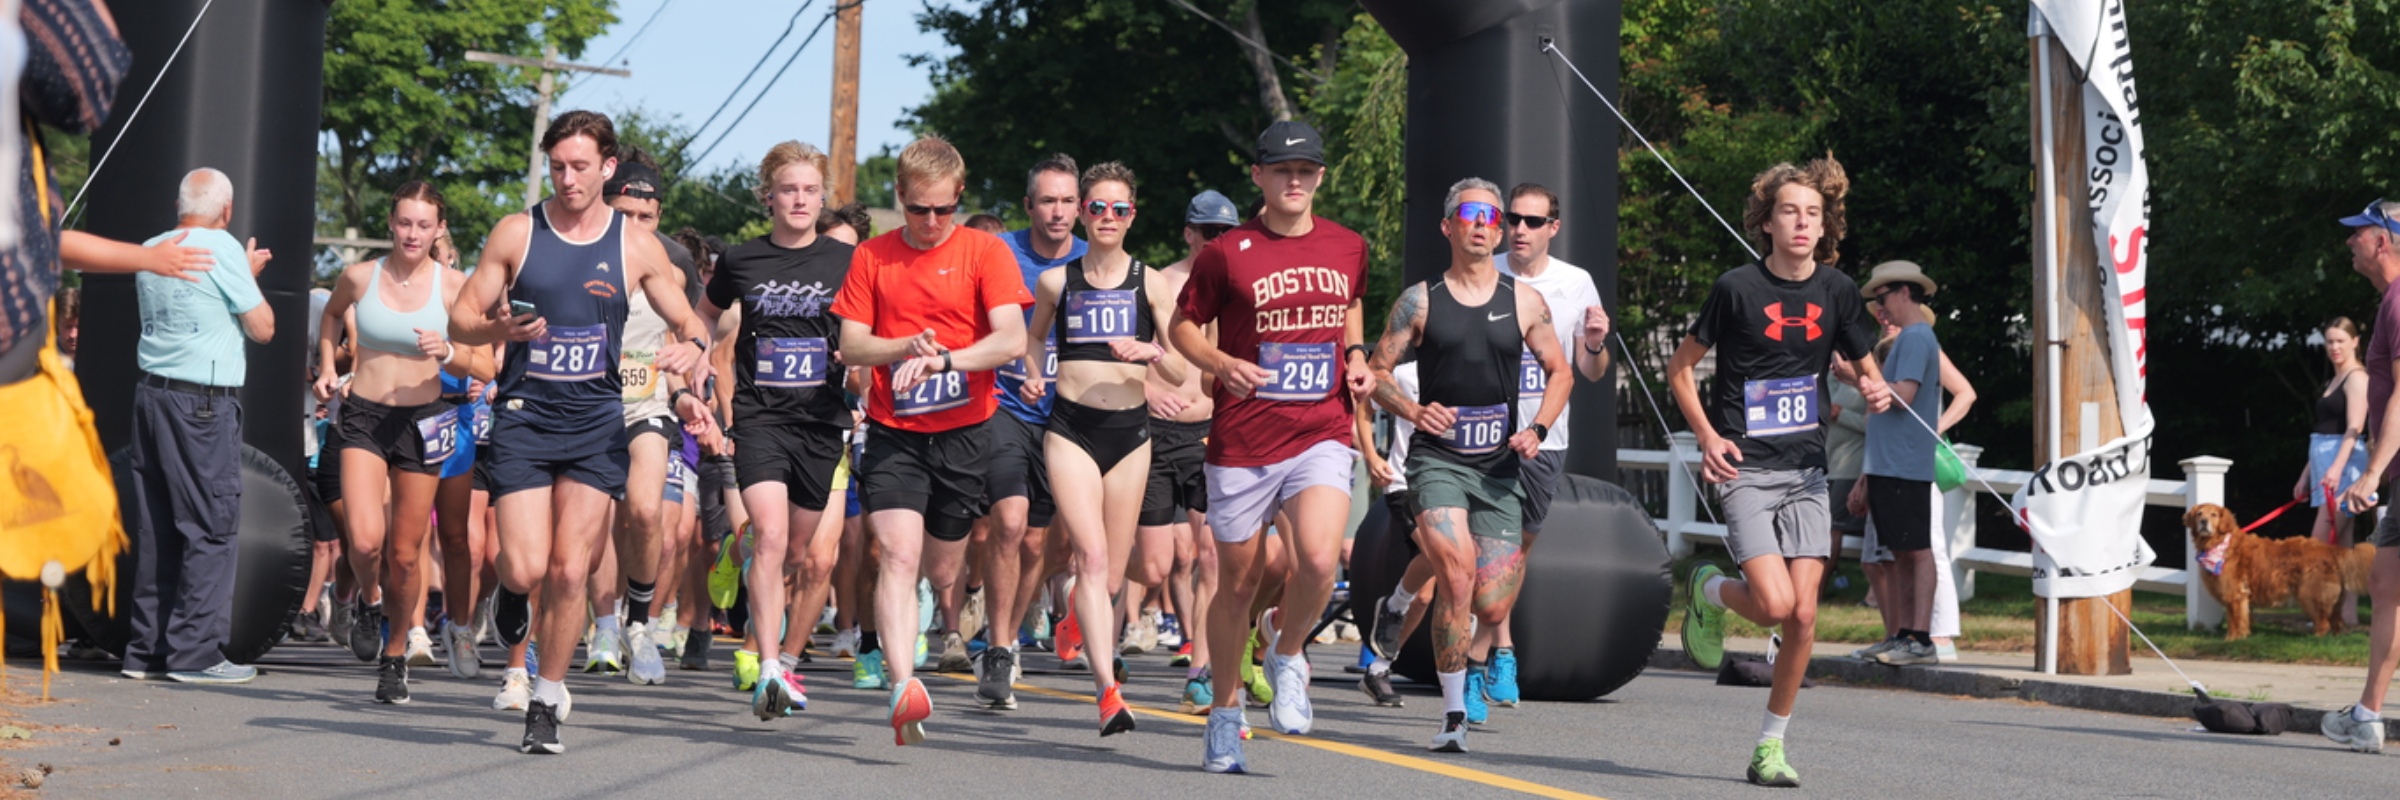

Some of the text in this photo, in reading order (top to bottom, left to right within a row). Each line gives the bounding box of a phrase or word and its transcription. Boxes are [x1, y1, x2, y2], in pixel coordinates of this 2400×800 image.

[1251, 266, 1349, 308] BOSTON
[1087, 307, 1129, 333] 101
[1255, 304, 1348, 333] COLLEGE
[551, 343, 600, 372] 287
[784, 354, 813, 379] 24
[915, 370, 961, 403] 278
[1282, 361, 1329, 391] 294
[1777, 394, 1807, 425] 88
[1461, 420, 1503, 446] 106
